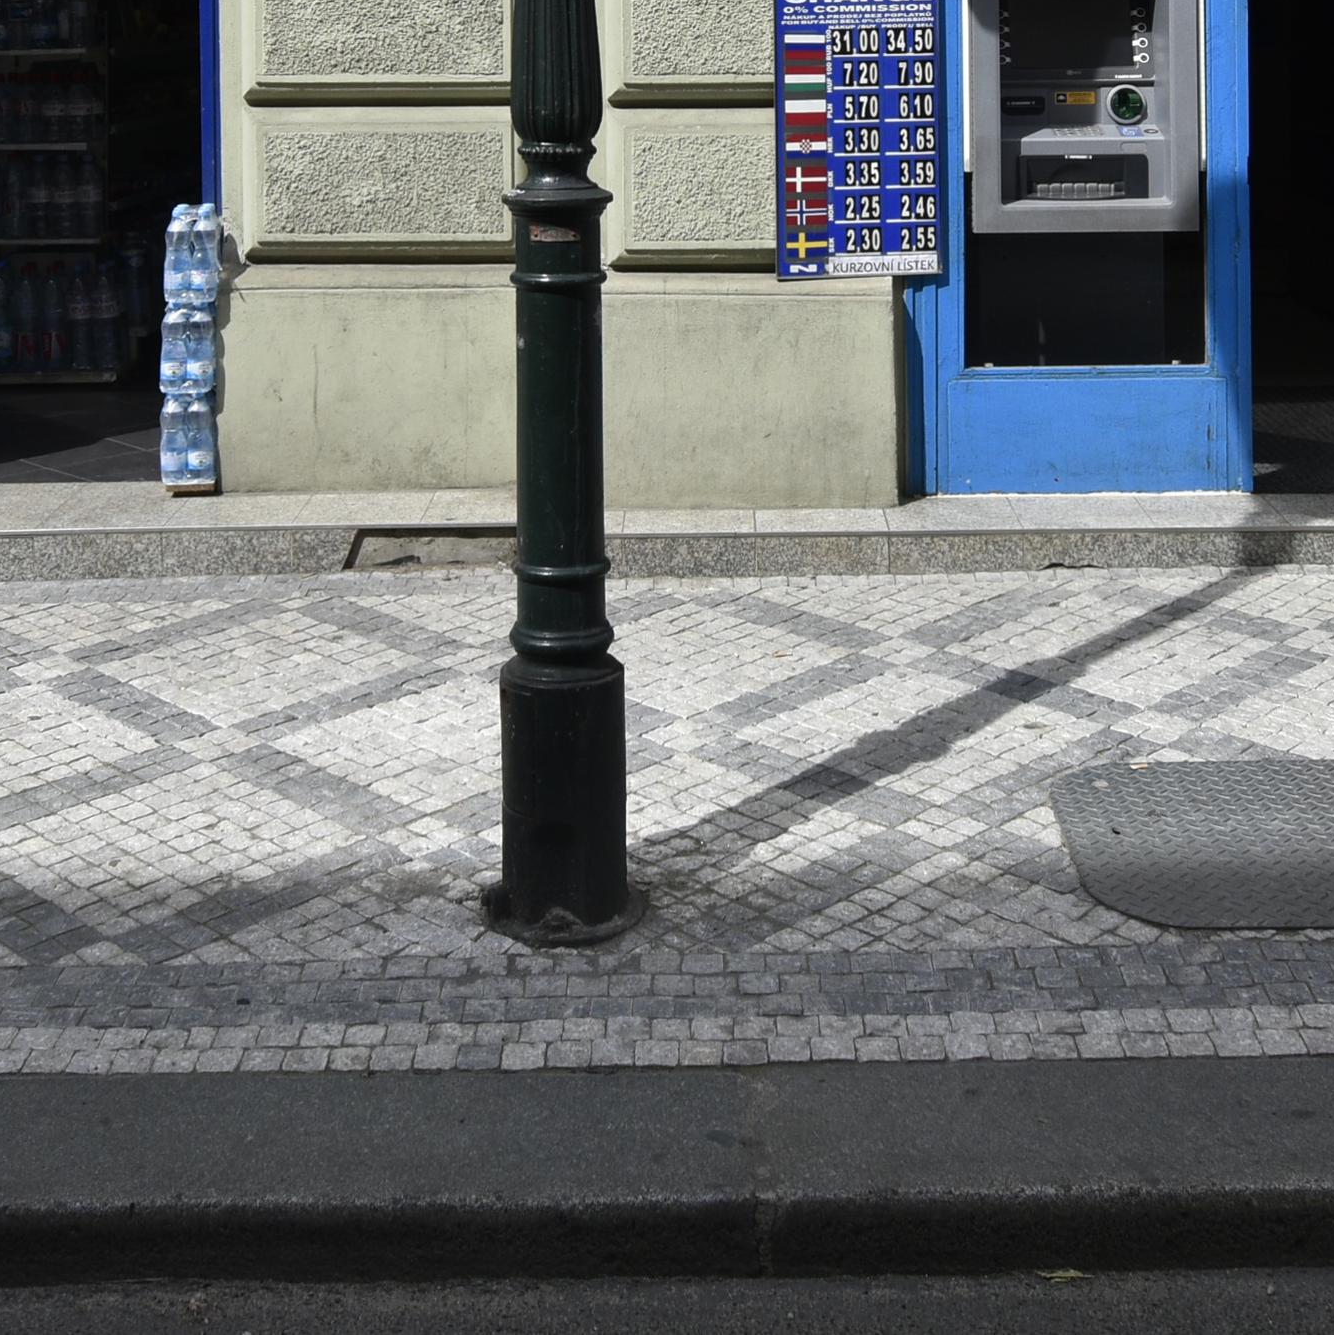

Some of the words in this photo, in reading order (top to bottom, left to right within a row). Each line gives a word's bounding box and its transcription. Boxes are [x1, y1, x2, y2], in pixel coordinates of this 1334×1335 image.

[813, 4, 932, 13] COMMISSION
[832, 29, 879, 54] 31,00
[887, 28, 933, 54] 34,50
[843, 62, 878, 86] 7,20
[898, 61, 933, 85] 7,90
[845, 95, 878, 120] 5,70
[900, 94, 933, 118] 6,10
[845, 128, 879, 152] 3,30
[900, 127, 934, 152] 3,65
[846, 162, 879, 186] 3,35
[901, 161, 934, 185] 3,59
[846, 196, 880, 220] 2,25
[901, 195, 935, 219] 2,46
[847, 228, 880, 252] 2,30
[901, 226, 935, 251] 2,55
[832, 259, 894, 273] KURZOVNÍ
[897, 257, 935, 272] LÍSTEK
